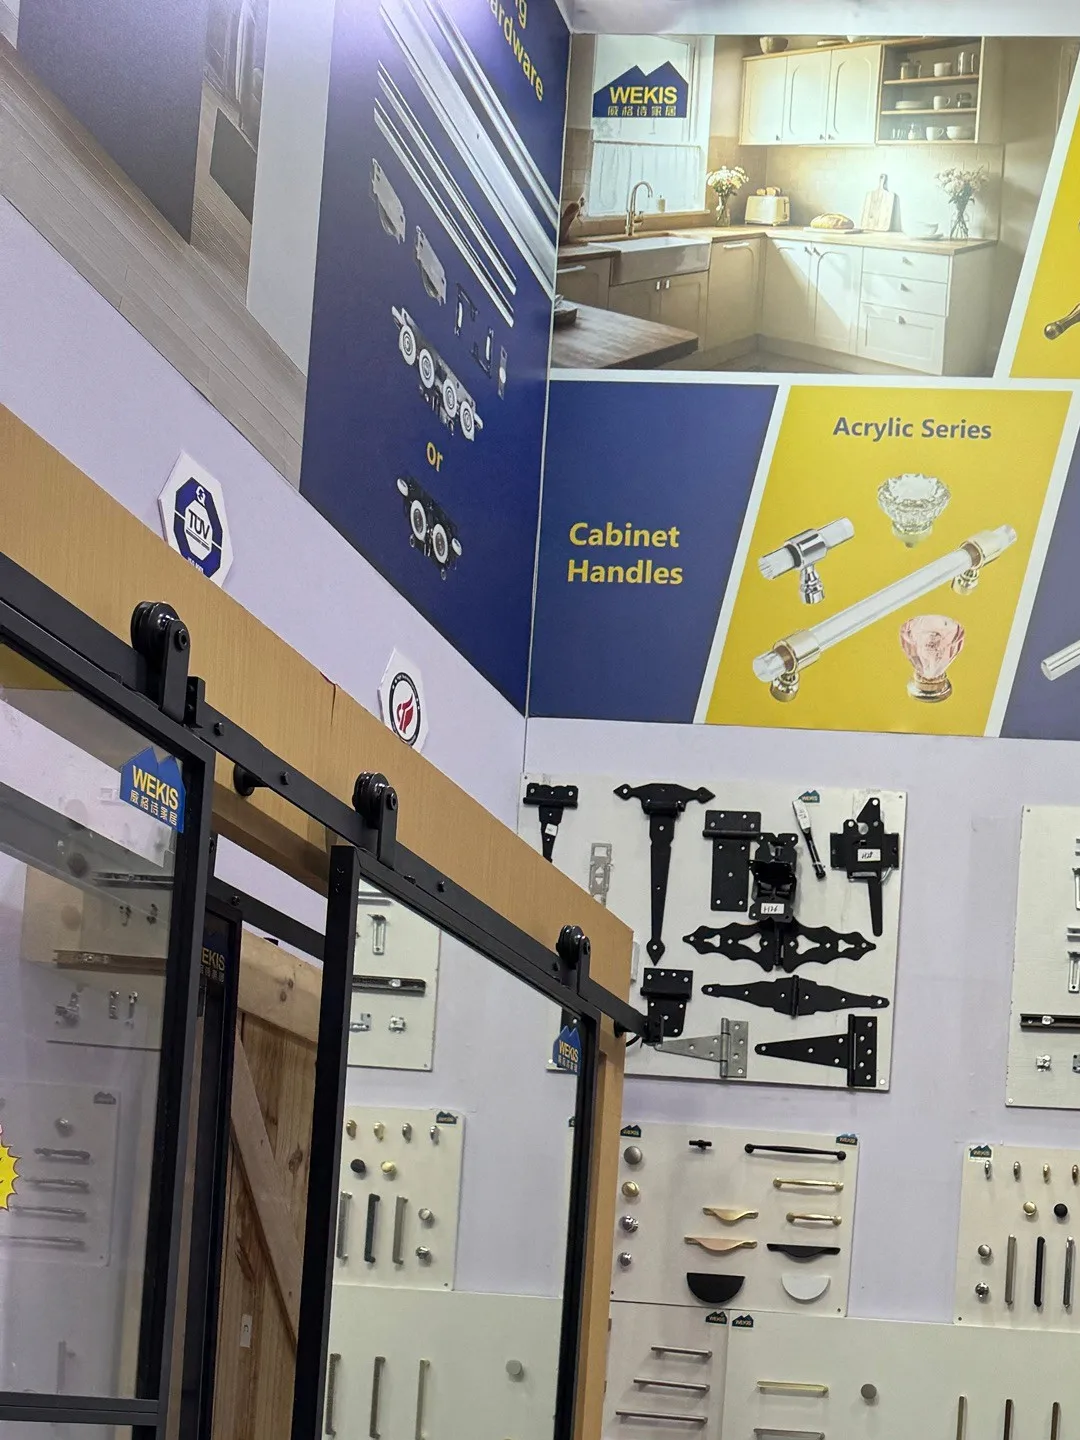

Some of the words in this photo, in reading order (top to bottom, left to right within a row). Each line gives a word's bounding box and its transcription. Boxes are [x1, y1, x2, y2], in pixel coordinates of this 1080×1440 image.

[486, 0, 544, 102] ardware
[609, 86, 678, 105] WEKIS
[832, 416, 914, 443] Acrylic
[920, 417, 993, 441] Series
[425, 441, 444, 471] Or
[568, 521, 681, 549] Cabinet
[567, 559, 684, 586] Handles
[132, 764, 179, 811] WEKIS
[202, 946, 225, 972] EKIS
